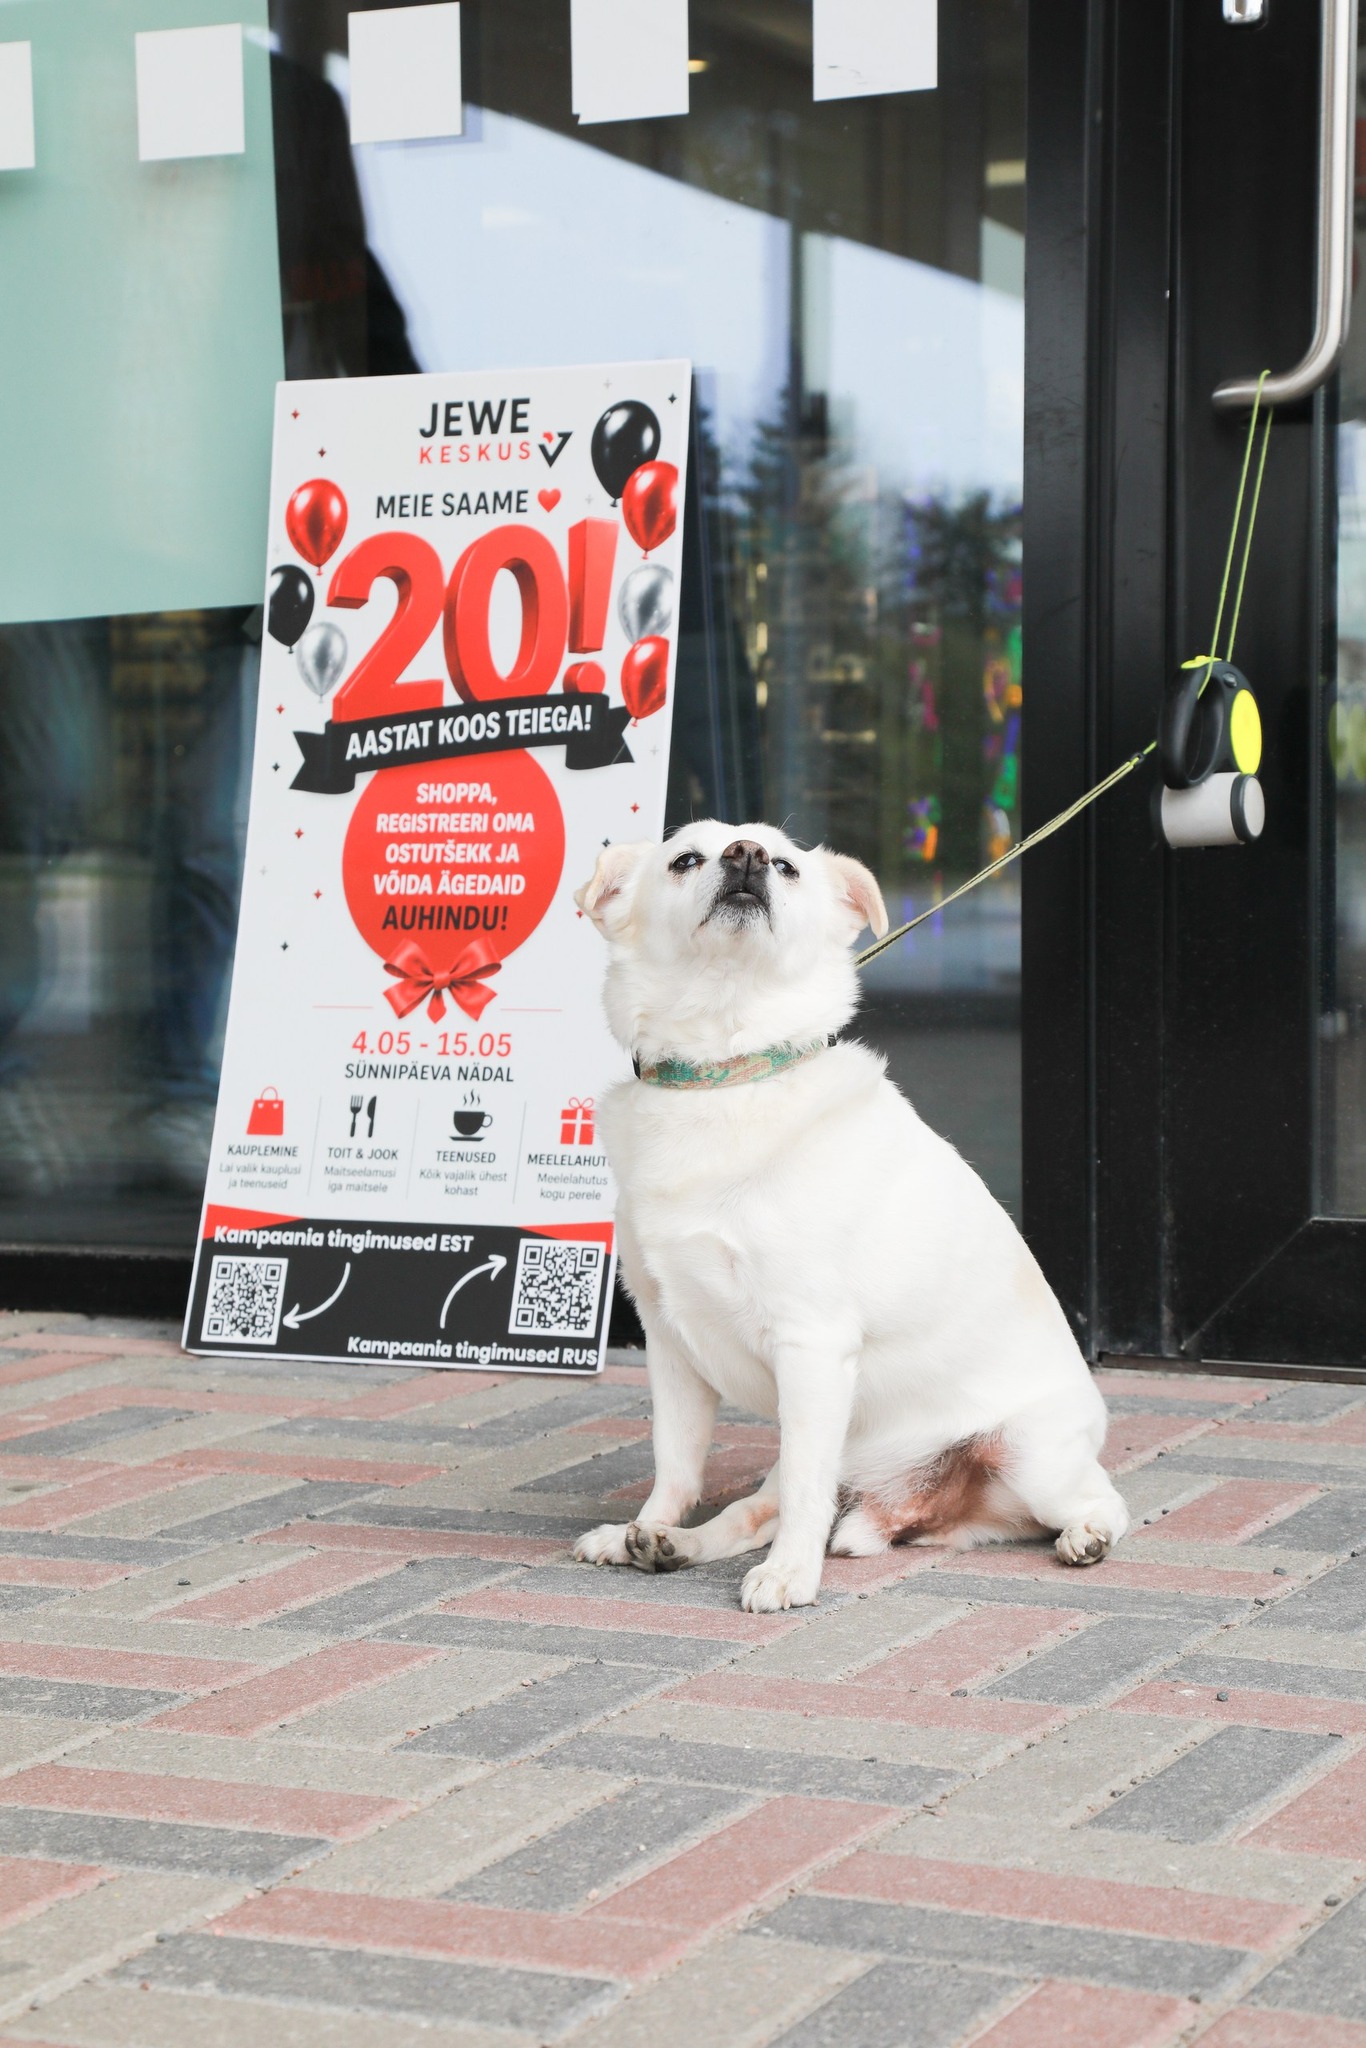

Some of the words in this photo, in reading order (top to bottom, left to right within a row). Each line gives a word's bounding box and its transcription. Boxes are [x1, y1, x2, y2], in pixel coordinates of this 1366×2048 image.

[419, 398, 531, 438] JEWE
[419, 441, 531, 465] KESKUS
[376, 493, 433, 518] MEIE
[442, 489, 529, 516] SAAME
[326, 517, 620, 723] 20!
[345, 722, 431, 761] AASTAT
[438, 712, 501, 745] KOOS
[505, 704, 592, 736] TEIEGA!
[416, 782, 498, 806] SHOPPA,
[376, 812, 488, 833] REGISTREERI
[492, 812, 535, 832] OMA
[385, 839, 492, 863] OSTUTŠEKK
[495, 843, 520, 863] JA
[373, 870, 433, 895] VÕIDA
[436, 870, 526, 895] ÄGEDAID
[381, 905, 508, 931] AUHINDU!
[352, 1030, 411, 1055] 4.05
[436, 1032, 512, 1057] 15.05
[344, 1060, 451, 1081] SÜNNIPÄEVA
[457, 1062, 514, 1082] NÄDAL
[227, 1144, 299, 1157] KAUPLEMINE
[327, 1147, 353, 1159] TOIT
[355, 1148, 364, 1159] &
[367, 1148, 399, 1160] JOOK
[436, 1150, 496, 1163] TEENUSED
[527, 1153, 611, 1167] MEELELAHUT
[219, 1162, 234, 1173] Lai
[236, 1163, 258, 1174] valik
[261, 1164, 302, 1176] kauplusi
[324, 1166, 397, 1178] Maitseelamusi
[419, 1168, 441, 1180] Kõik
[444, 1169, 477, 1182] vajalik
[479, 1170, 507, 1182] ühest
[537, 1173, 608, 1186] Meelelahutus
[228, 1179, 238, 1190] ja
[240, 1179, 288, 1190] teenuseid
[328, 1181, 342, 1193] iga
[345, 1181, 388, 1193] maitsele
[444, 1185, 478, 1196] kohast
[540, 1188, 565, 1201] kogu
[569, 1189, 601, 1201] perele
[214, 1225, 324, 1250] Kampaania
[327, 1228, 437, 1254] tingimused
[440, 1234, 474, 1253] EST
[347, 1336, 451, 1360] Kampaania
[455, 1341, 559, 1364] tingimused
[562, 1348, 598, 1366] RUS
